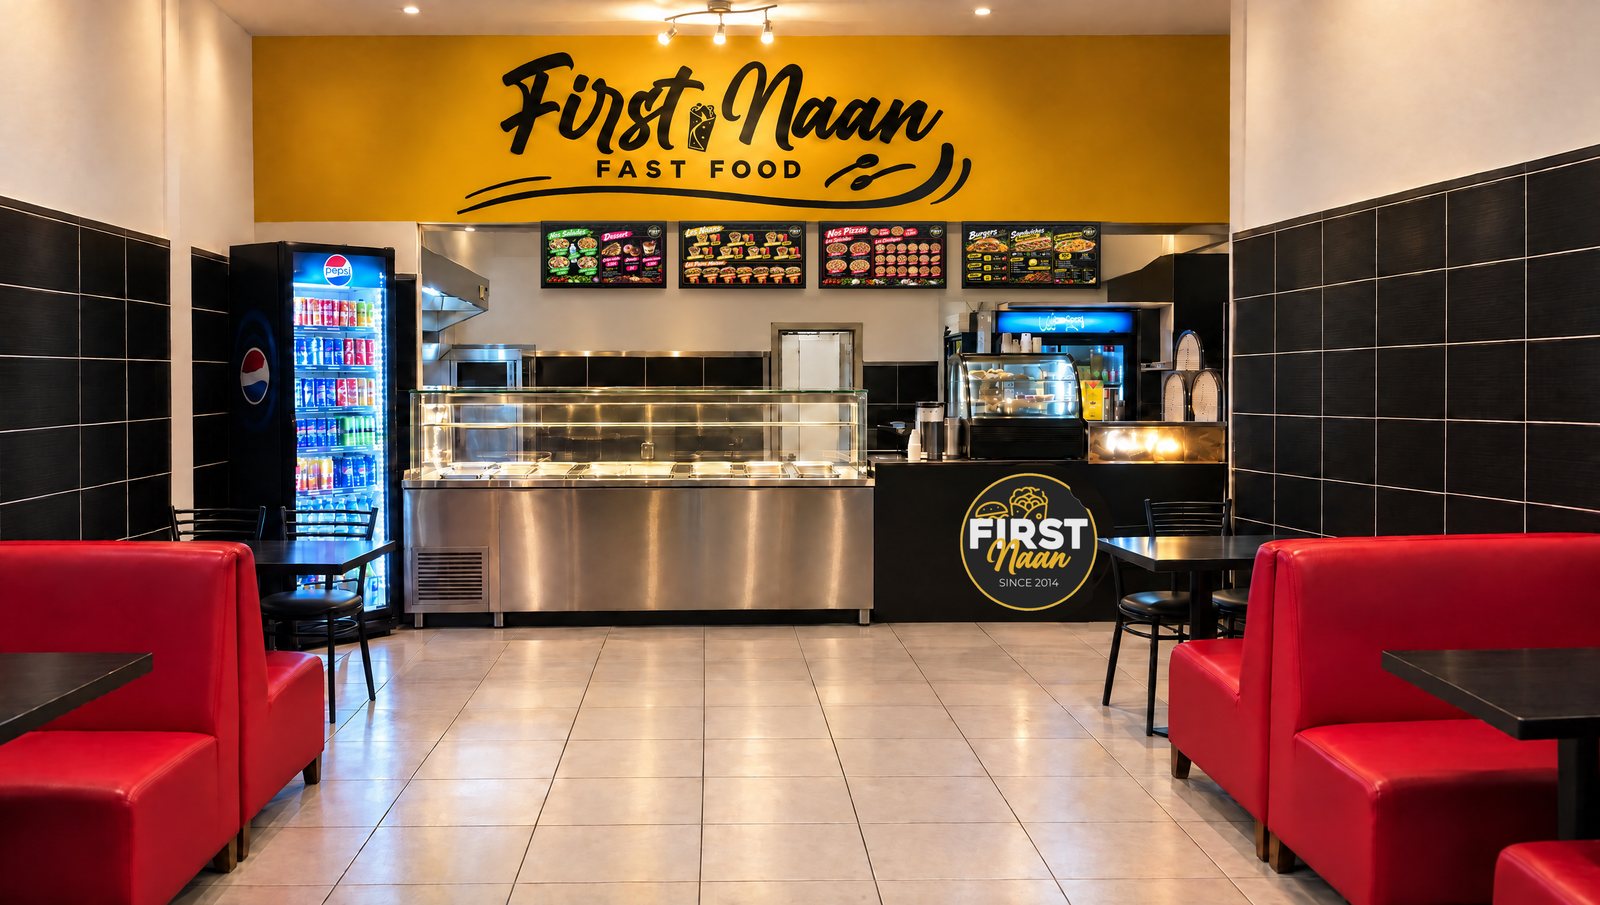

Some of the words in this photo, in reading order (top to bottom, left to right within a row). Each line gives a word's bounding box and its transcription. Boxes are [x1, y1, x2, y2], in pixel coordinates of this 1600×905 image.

[500, 52, 705, 155] First
[721, 60, 943, 151] Naan
[596, 159, 686, 179] FAST
[710, 159, 802, 179] FOOD
[603, 231, 628, 242] Dessert
[827, 229, 842, 238] Nos
[843, 226, 867, 236] Pizzas
[968, 229, 998, 240] Burgers
[1010, 228, 1045, 239] Sandwiches
[325, 266, 351, 275] pepsi
[969, 518, 1088, 549] FIRST
[986, 538, 1072, 575] Naan
[999, 578, 1032, 588] SINCE
[1035, 578, 1059, 588] 2014
